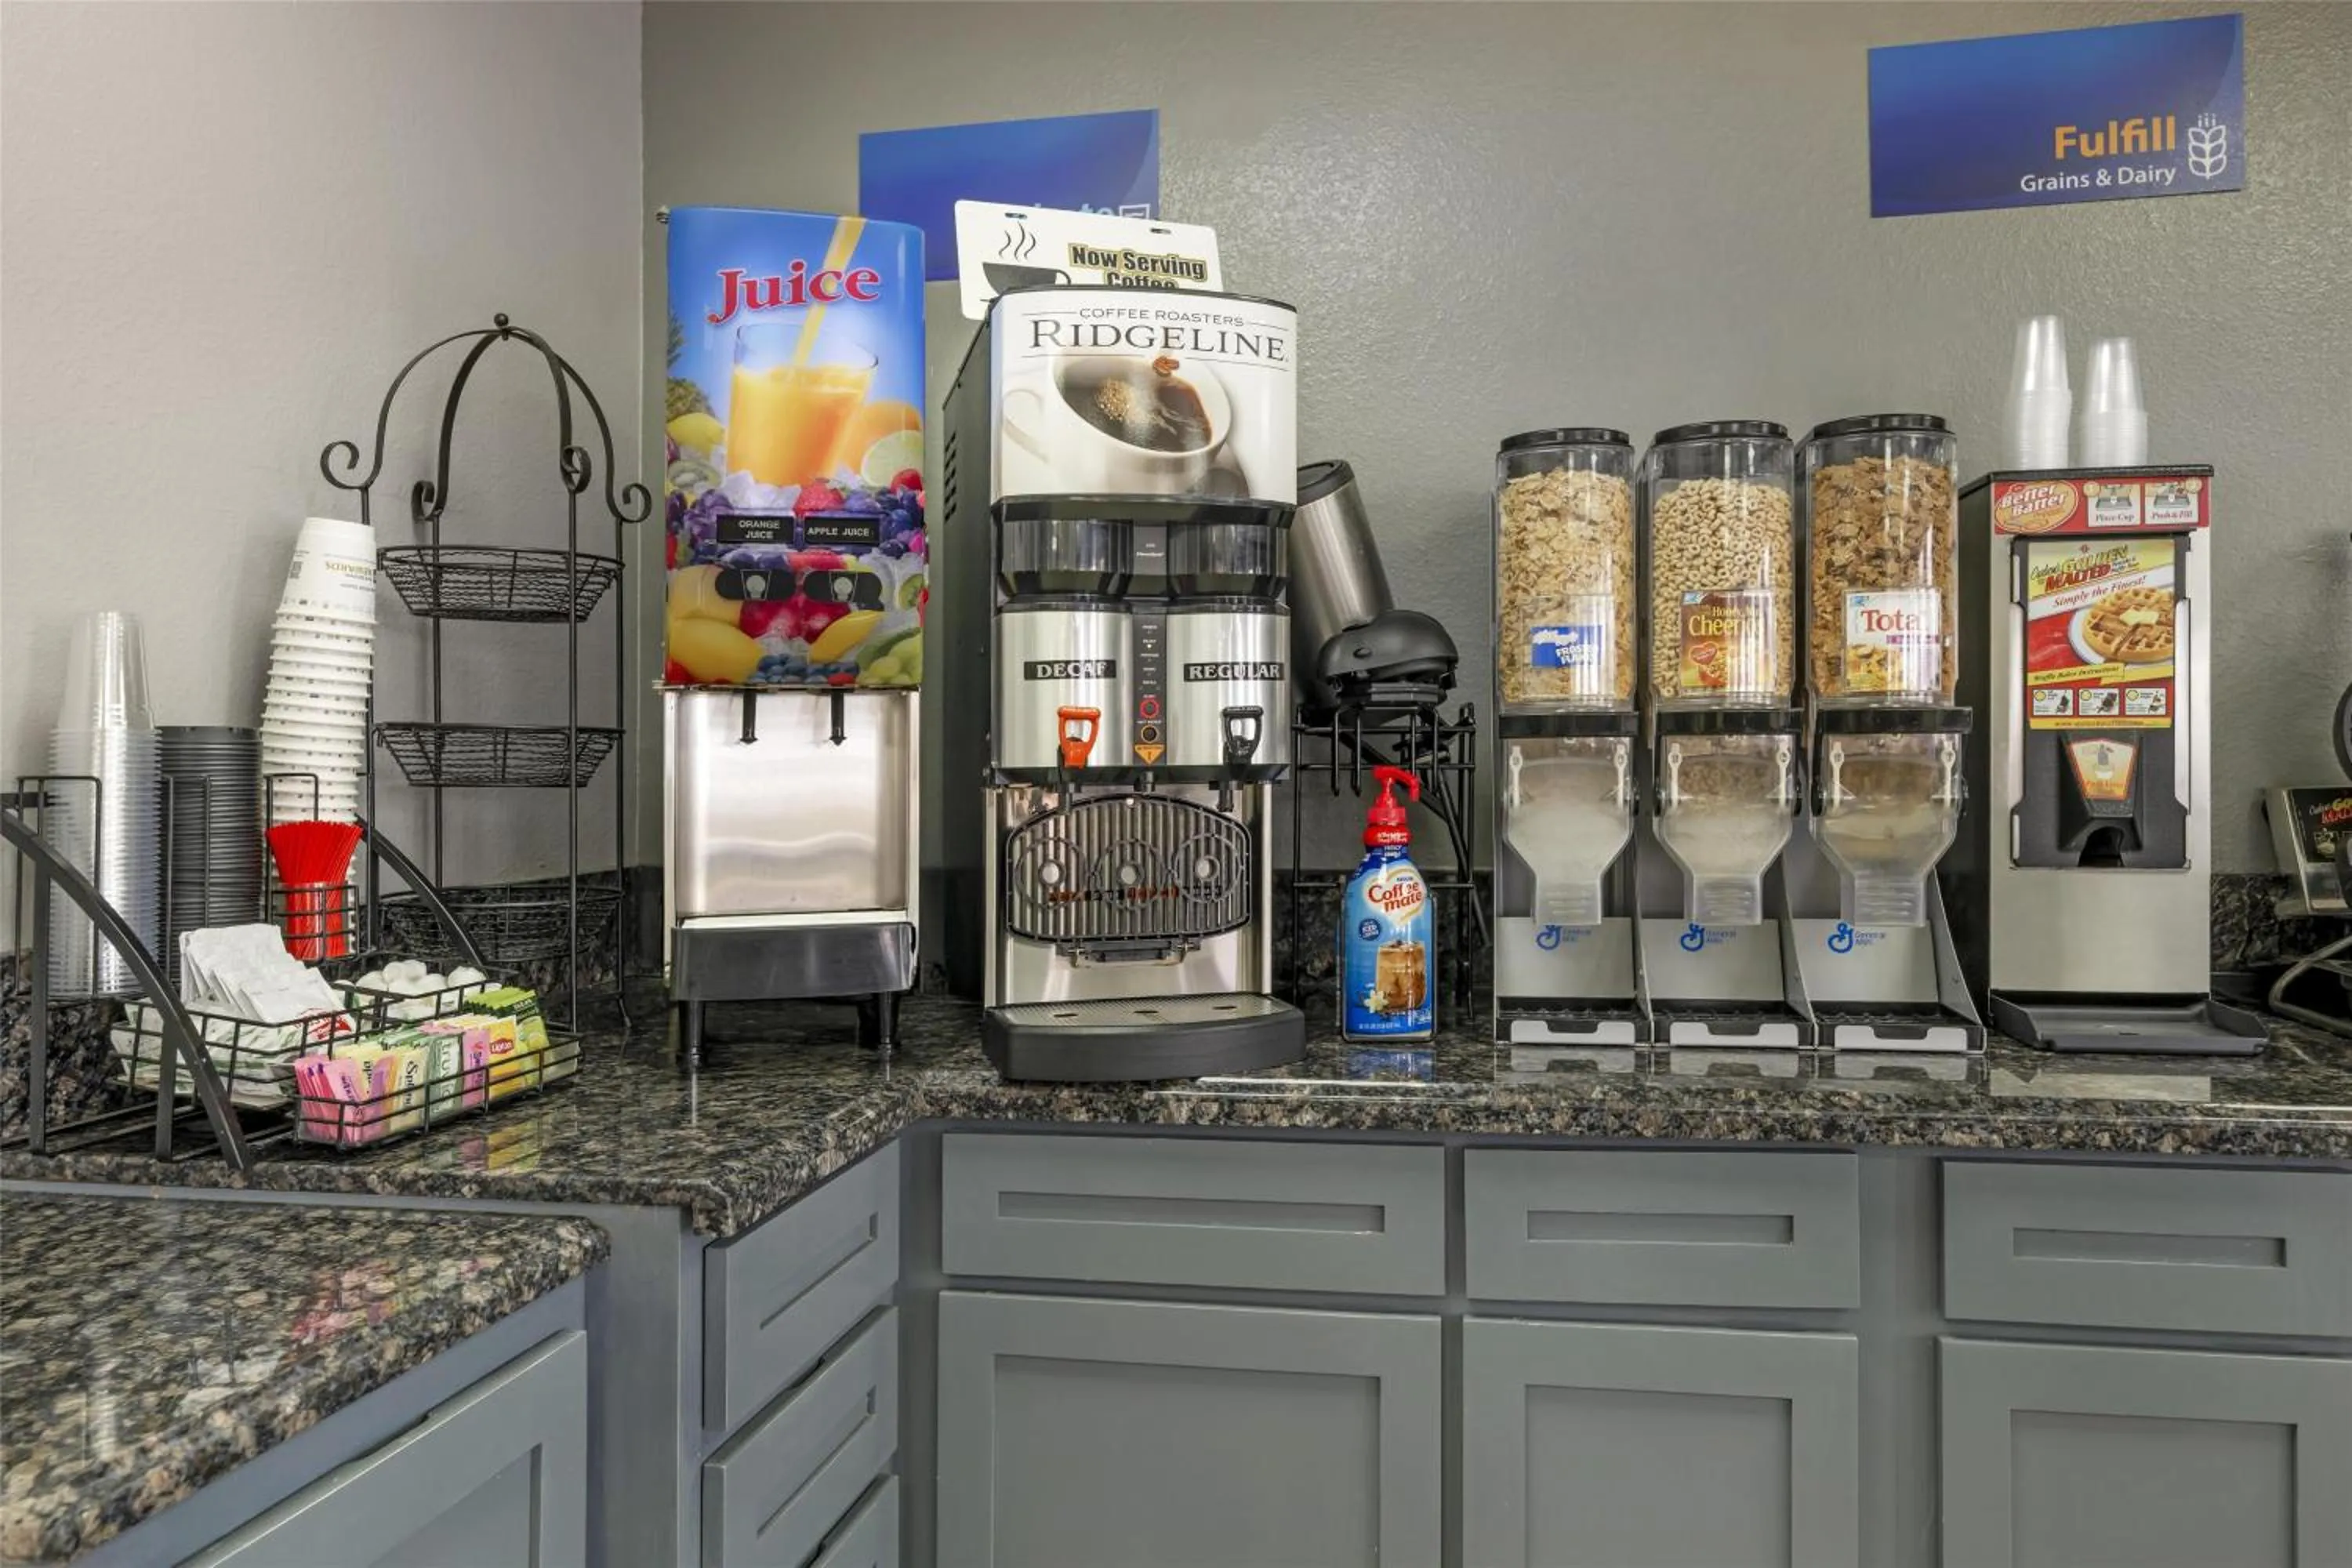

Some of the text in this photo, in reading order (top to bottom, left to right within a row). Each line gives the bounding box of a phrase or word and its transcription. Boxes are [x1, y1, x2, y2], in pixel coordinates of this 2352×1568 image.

[2054, 115, 2176, 160] Fulfill
[2020, 165, 2177, 193] Grains & Dairy
[1071, 245, 1205, 281] Now Serving
[707, 258, 881, 324] Juice
[1079, 308, 1245, 327] COFFEE ROASTERS
[1029, 318, 1287, 363] RIDGELINE
[739, 520, 781, 530] ORANGE
[745, 530, 774, 539] JUICE
[808, 526, 869, 537] APPLE JUICE
[2052, 590, 2089, 608] Simply
[2091, 585, 2109, 598] the
[1860, 608, 1926, 632] Tota
[1035, 661, 1107, 679] DECAF
[1188, 663, 1282, 680] REGULAR
[1384, 891, 1422, 913] mate
